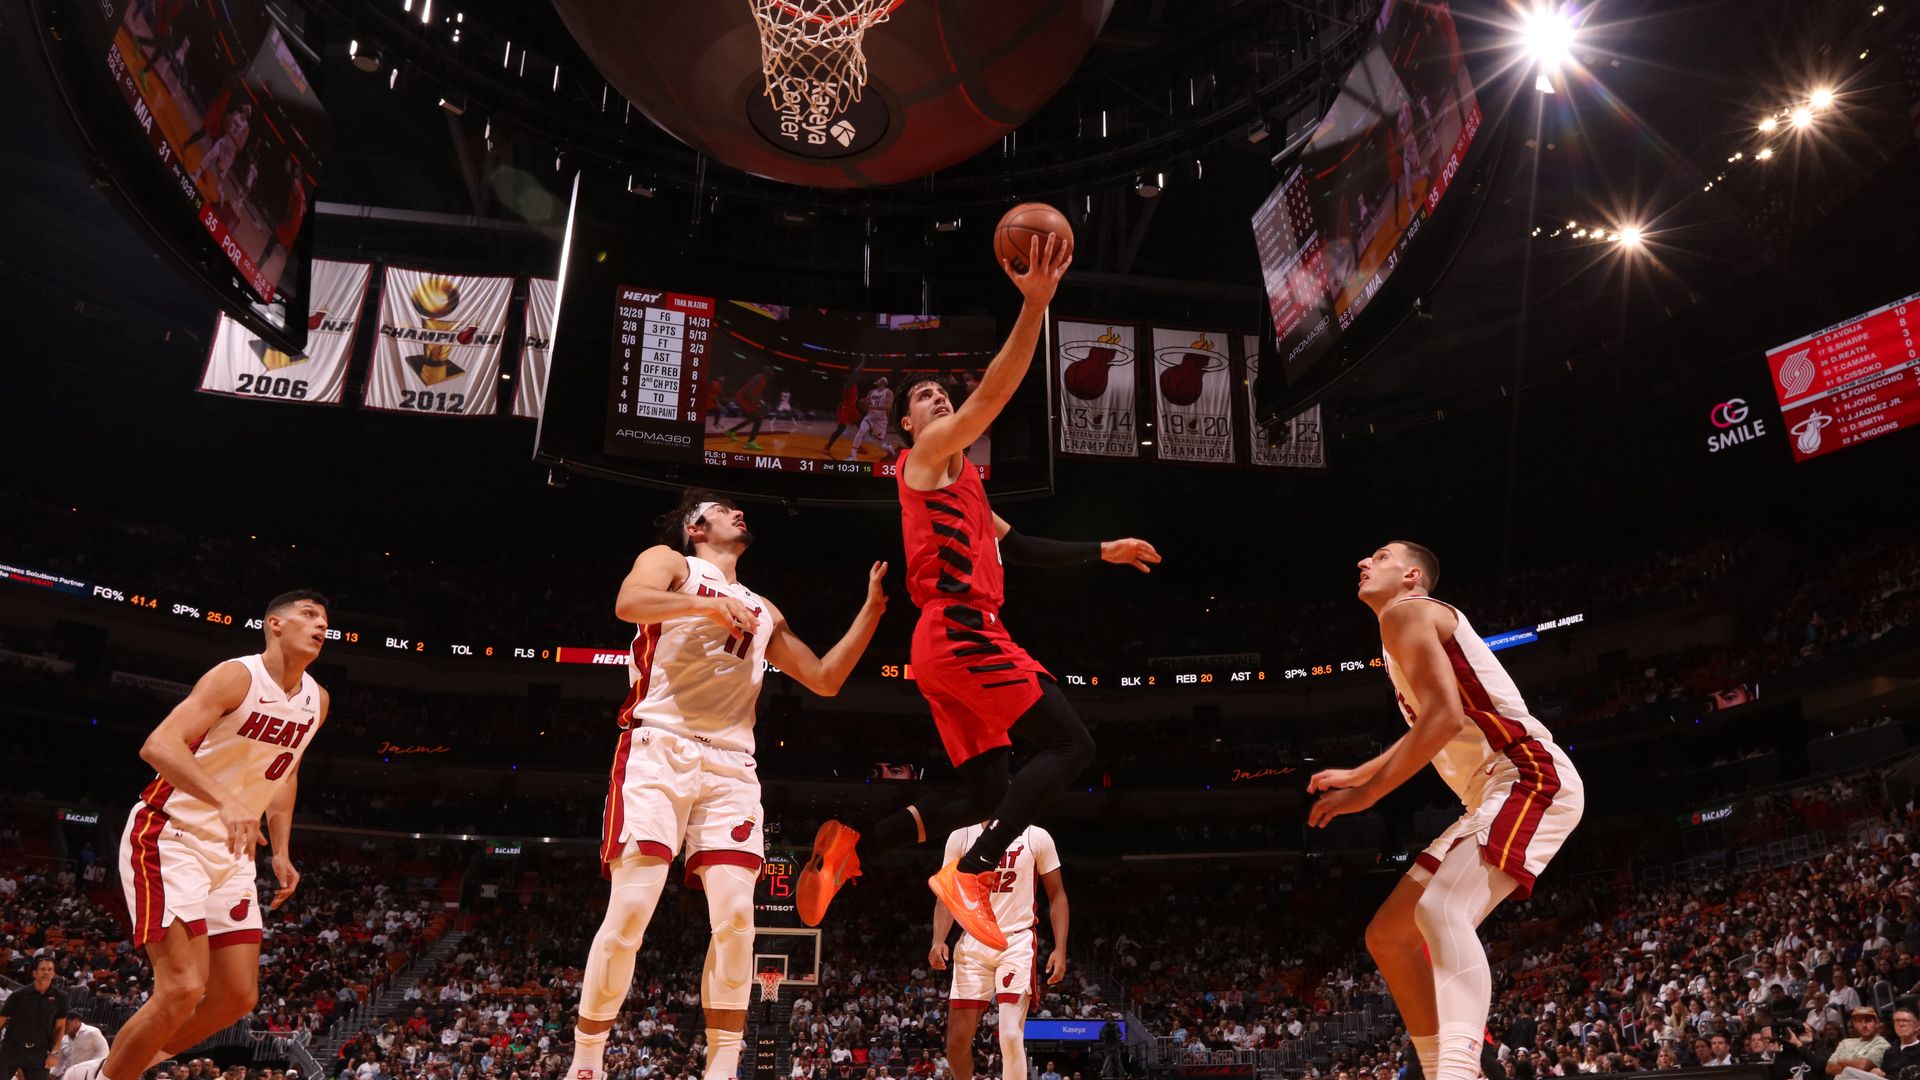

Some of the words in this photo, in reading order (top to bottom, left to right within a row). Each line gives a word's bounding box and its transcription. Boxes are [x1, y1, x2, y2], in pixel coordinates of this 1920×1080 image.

[134, 97, 152, 134] MIA
[159, 140, 171, 162] 31
[1429, 187, 1439, 208] 35
[1442, 153, 1459, 187] POR
[206, 212, 218, 232] 35
[222, 234, 241, 266] POR
[1365, 273, 1382, 299] MIA
[1388, 250, 1398, 269] 31
[623, 291, 662, 303] HEAT
[619, 306, 643, 318] 12/29
[660, 312, 670, 321] FG
[688, 316, 710, 328] 14/31
[1824, 324, 1863, 343] D.AVDIJA
[1894, 306, 1906, 316] 10
[622, 321, 637, 332] 2/8
[652, 324, 658, 333] 3
[660, 326, 676, 336] PTS
[689, 330, 707, 341] 5/13
[1288, 315, 1330, 362] AROMA360
[622, 334, 636, 345] 5/6
[658, 339, 668, 348] FT
[690, 344, 704, 354] 2/3
[1828, 333, 1869, 353] S.SHARPE
[1830, 345, 1867, 363] D.REATH
[1902, 329, 1909, 337] 3
[624, 348, 630, 358] 6
[654, 352, 670, 362] AST
[693, 357, 699, 367] 8
[1833, 352, 1877, 373] T.CAMARA
[1905, 339, 1912, 347] 0
[1836, 362, 1882, 383] S.CISSOKO
[1908, 349, 1916, 358] 0
[623, 362, 629, 372] 4
[643, 364, 660, 374] OFF
[661, 367, 678, 377] REB
[692, 371, 698, 380] 8
[236, 374, 309, 400] 2006
[622, 376, 628, 385] 5
[653, 379, 663, 389] CH
[664, 380, 678, 390] PTS
[691, 384, 697, 394] 7
[1841, 373, 1903, 400] S.FONTECCHIO
[400, 390, 464, 414] 2012
[620, 389, 627, 399] 4
[654, 392, 664, 403] TO
[690, 398, 696, 408] 7
[1844, 394, 1877, 410] N.JOVIC
[618, 403, 628, 413] 18
[639, 405, 650, 415] PTS
[651, 406, 658, 416] IN
[658, 407, 676, 418] PAINT
[687, 411, 697, 421] 18
[1847, 402, 1888, 421] J.JAQUEZ
[1889, 397, 1903, 407] JR.
[1066, 408, 1087, 429] 13
[1110, 410, 1132, 431] 14
[1162, 414, 1184, 434] 19
[1204, 416, 1229, 437] 20
[1850, 414, 1884, 431] D.SMITH
[616, 428, 691, 444] AROMA360
[1297, 423, 1320, 442] 23
[1707, 419, 1766, 452] SMILE
[1853, 421, 1898, 441] A.WIGGINS
[1065, 439, 1133, 452] CHAMPIONS
[1163, 445, 1230, 458] CHAMPIONS
[755, 456, 782, 470] MIA
[800, 460, 814, 471] 31
[837, 464, 860, 473] 10:31
[881, 465, 896, 476] 35
[1256, 451, 1321, 463] CHAMPIONS
[26, 570, 58, 581] Solutions
[59, 577, 85, 587] Partner
[93, 585, 124, 602] FG%
[130, 594, 158, 609] 41.4
[172, 603, 200, 618] 3P%
[206, 611, 232, 626] 25.0
[244, 618, 265, 630] AS
[325, 630, 341, 640] EB
[345, 632, 359, 643] 13
[386, 637, 408, 650] BLK
[416, 642, 424, 652] 2
[451, 644, 473, 655] TOL
[485, 646, 493, 656] 6
[515, 648, 535, 658] FLS
[542, 650, 549, 659] 0
[593, 653, 630, 665] HEAT
[1536, 620, 1557, 632] JAIME
[1557, 613, 1584, 627] JAQUEZ
[1490, 638, 1509, 646] SPORTS
[1509, 632, 1533, 642] NETWORK
[881, 665, 899, 677] 35
[1066, 675, 1086, 685] TOL
[1091, 676, 1098, 685] 6
[1121, 676, 1141, 686] BLK
[1148, 676, 1155, 685] 2
[1176, 674, 1197, 683] REB
[1200, 673, 1213, 682] 20
[1231, 672, 1252, 681] AST
[1258, 671, 1265, 680] 8
[1285, 668, 1307, 679] 3P%
[1311, 664, 1332, 676] 38.5
[1340, 660, 1364, 672] FG%
[1369, 658, 1384, 668] 45.
[237, 711, 315, 749] HEAT
[377, 741, 452, 754] Jaime
[265, 752, 293, 781] 0
[1232, 767, 1296, 781] Jaime
[765, 864, 792, 875] 10:31
[770, 876, 788, 897] 15
[1062, 1026, 1086, 1035] Kaseya
